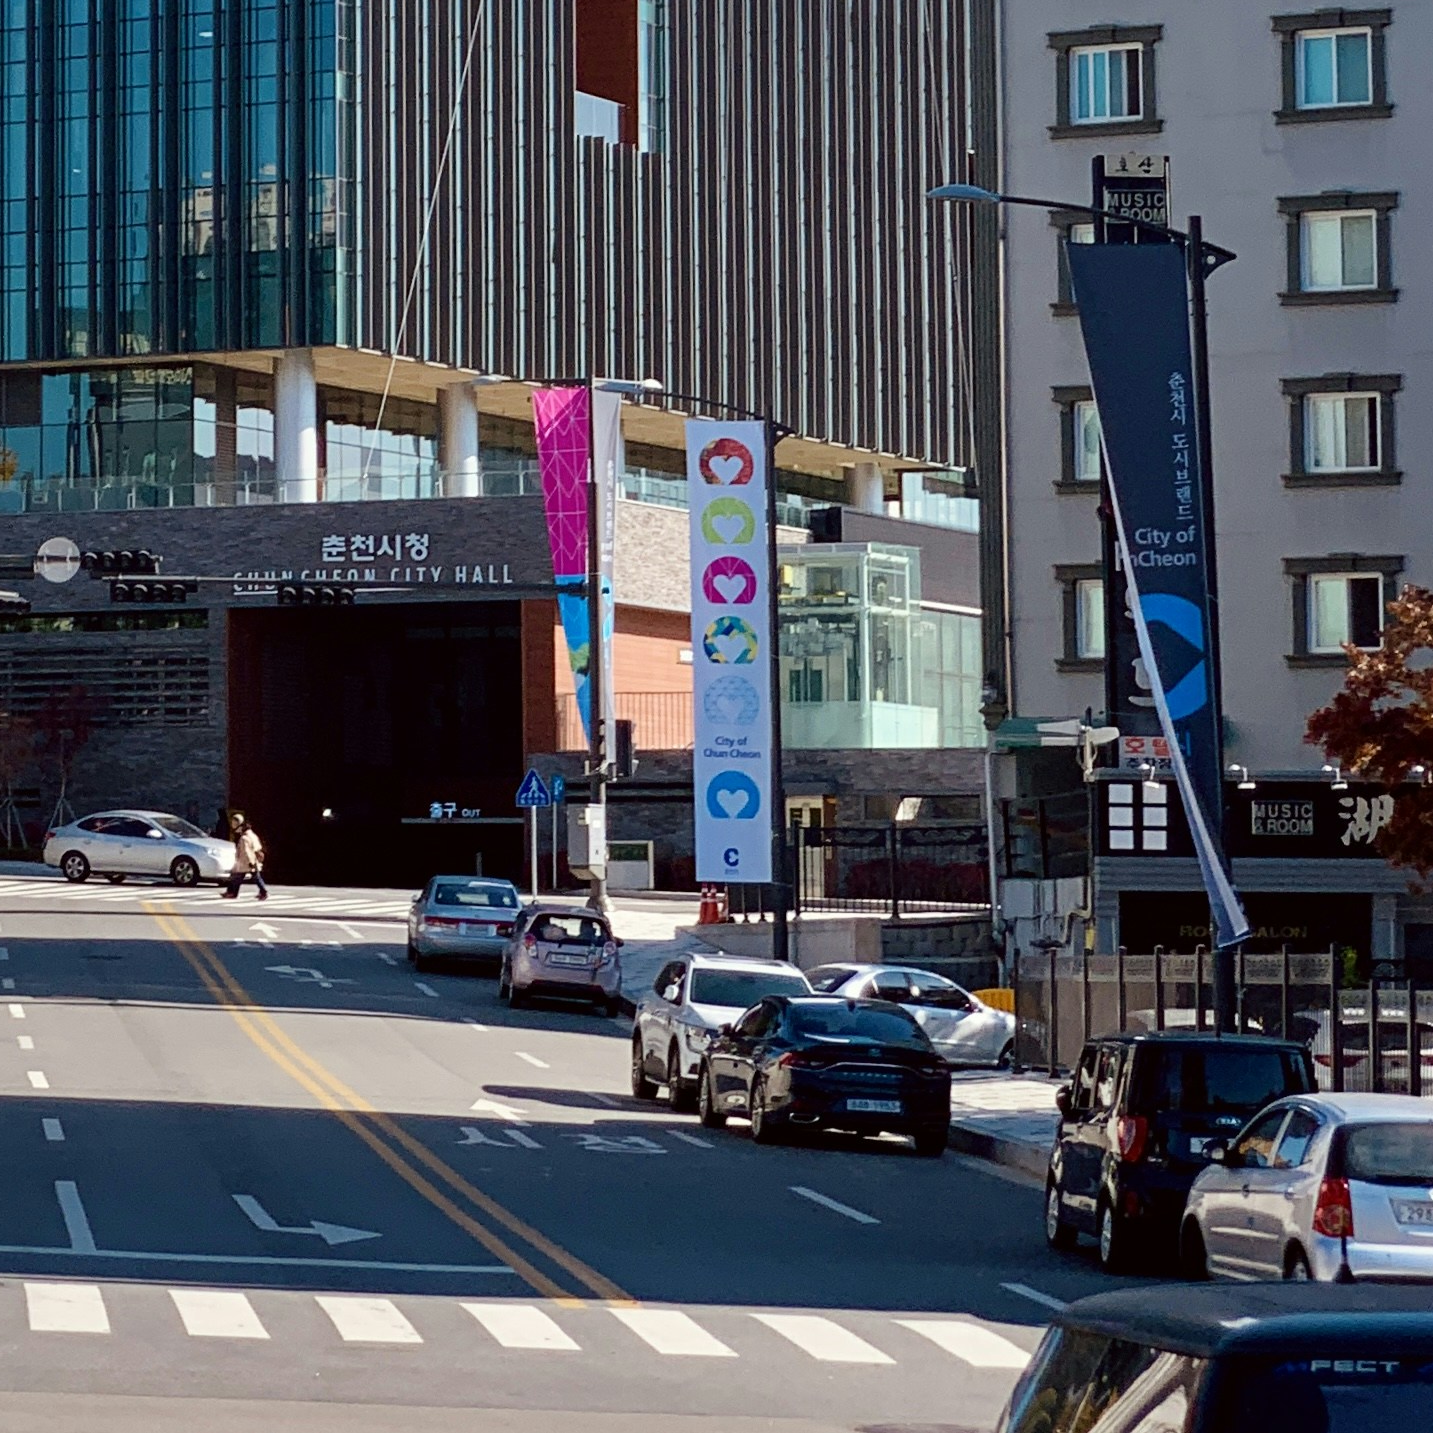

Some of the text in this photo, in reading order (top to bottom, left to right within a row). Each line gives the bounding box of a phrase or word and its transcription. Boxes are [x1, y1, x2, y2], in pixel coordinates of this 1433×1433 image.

[1108, 192, 1165, 207] MUSIC
[1168, 372, 1194, 520] 춘천시 도시브랜드
[1135, 524, 1196, 548] City of
[322, 533, 430, 562] 춘천시청
[390, 566, 442, 582] CITY
[455, 564, 513, 583] HALL
[715, 736, 748, 748] City of
[1254, 803, 1313, 818] MUSIC
